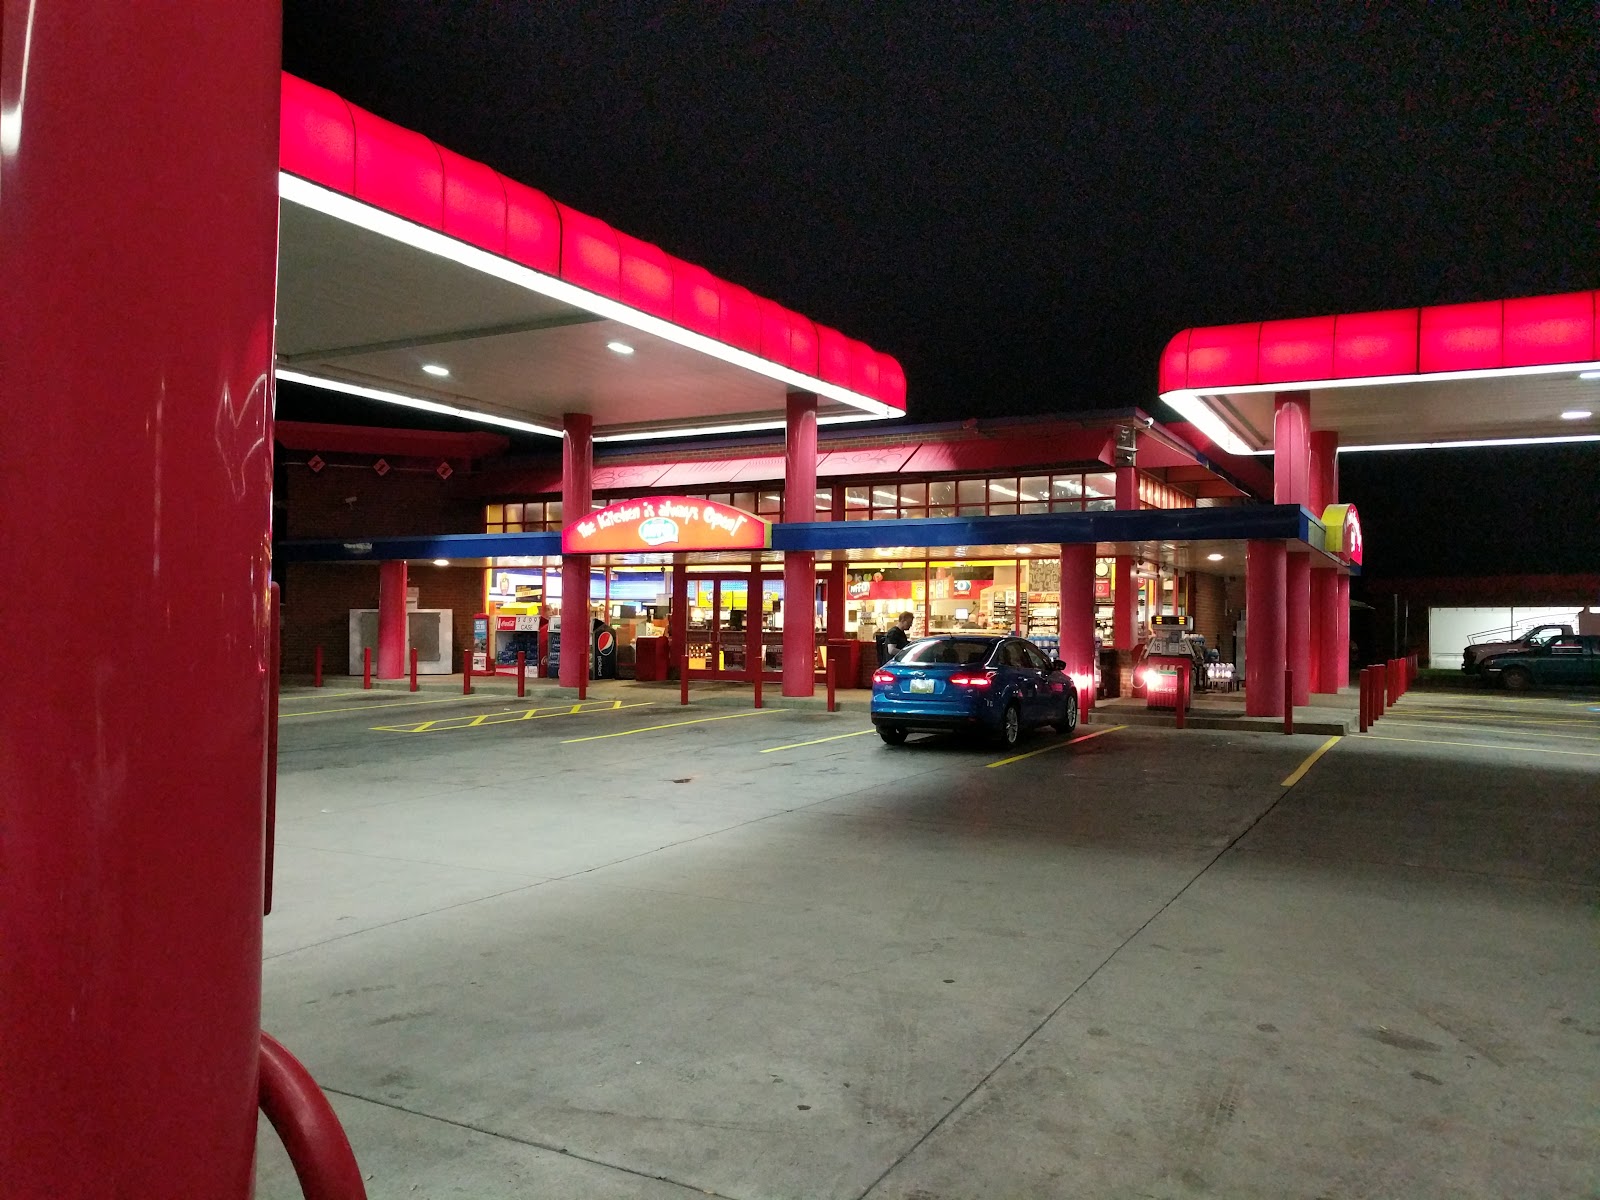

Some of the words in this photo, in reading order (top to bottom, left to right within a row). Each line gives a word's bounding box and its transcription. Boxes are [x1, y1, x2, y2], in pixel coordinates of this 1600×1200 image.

[577, 522, 596, 538] The
[597, 507, 640, 529] Kitchen
[643, 501, 655, 518] is
[658, 500, 699, 526] always
[704, 507, 747, 536] Open!
[1154, 643, 1161, 652] 16
[1180, 643, 1187, 652] 15
